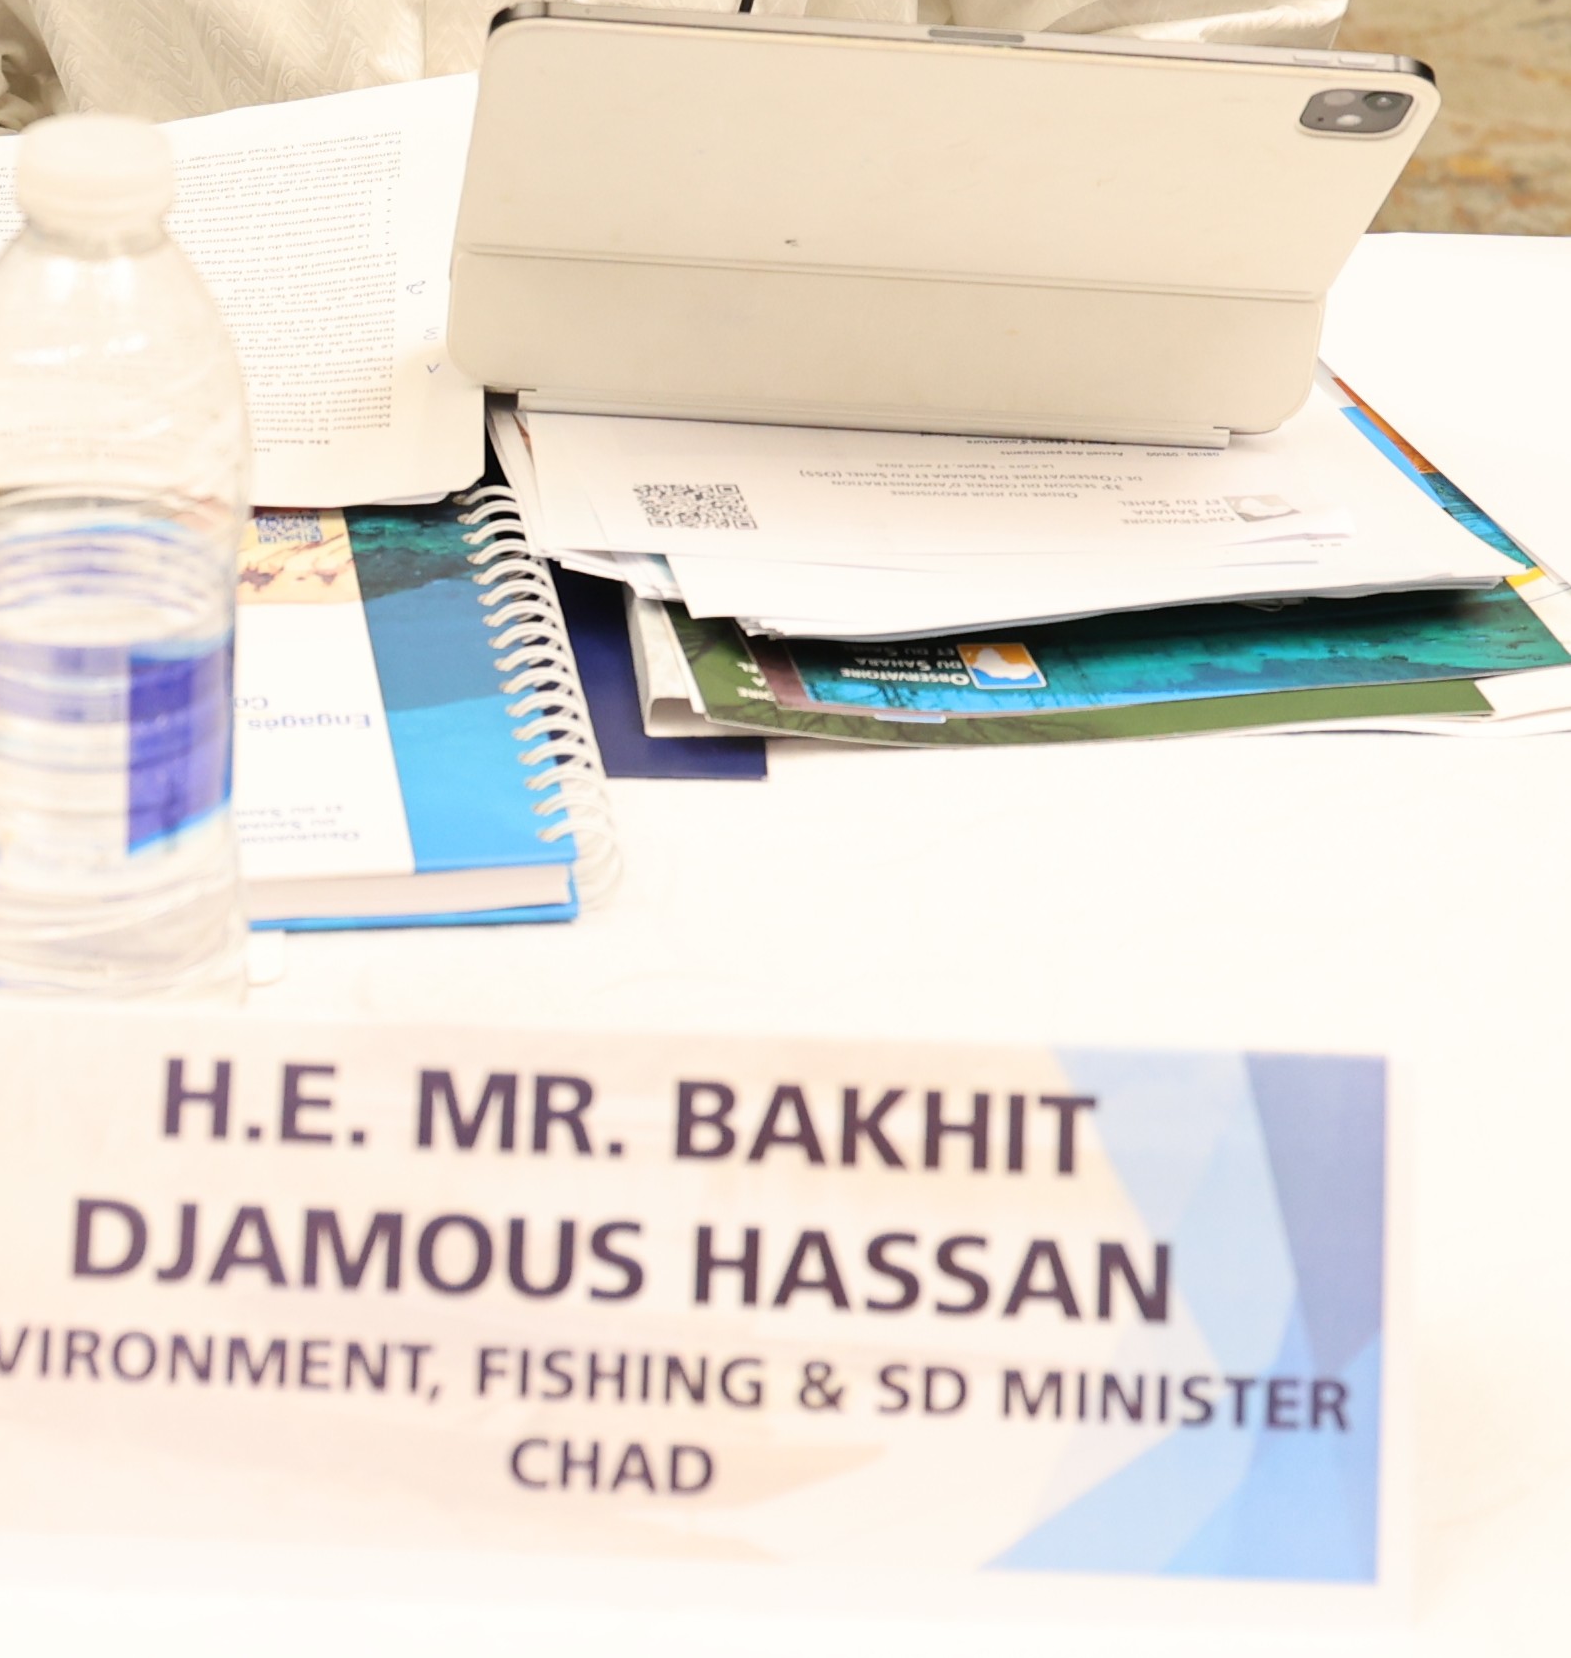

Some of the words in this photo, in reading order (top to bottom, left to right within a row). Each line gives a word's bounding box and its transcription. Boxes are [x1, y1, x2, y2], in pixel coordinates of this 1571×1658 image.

[1118, 500, 1170, 508] SAHEL
[1131, 508, 1200, 517] SAHARA
[854, 656, 931, 672] SAHARA
[936, 660, 962, 670] DU
[839, 667, 971, 686] OBSERVATOIRE
[248, 713, 371, 732] Engagés
[161, 1056, 367, 1147] H.E.
[413, 1066, 625, 1159] MR.
[671, 1078, 1099, 1178] BAKHIT
[69, 1196, 646, 1304] DJAMOUS
[691, 1222, 1172, 1326] HASSAN
[475, 1345, 765, 1410] FISHING
[795, 1359, 845, 1412] &
[875, 1362, 969, 1416] SD
[1000, 1367, 1352, 1432] MINISTER
[507, 1436, 716, 1496] CHAD
